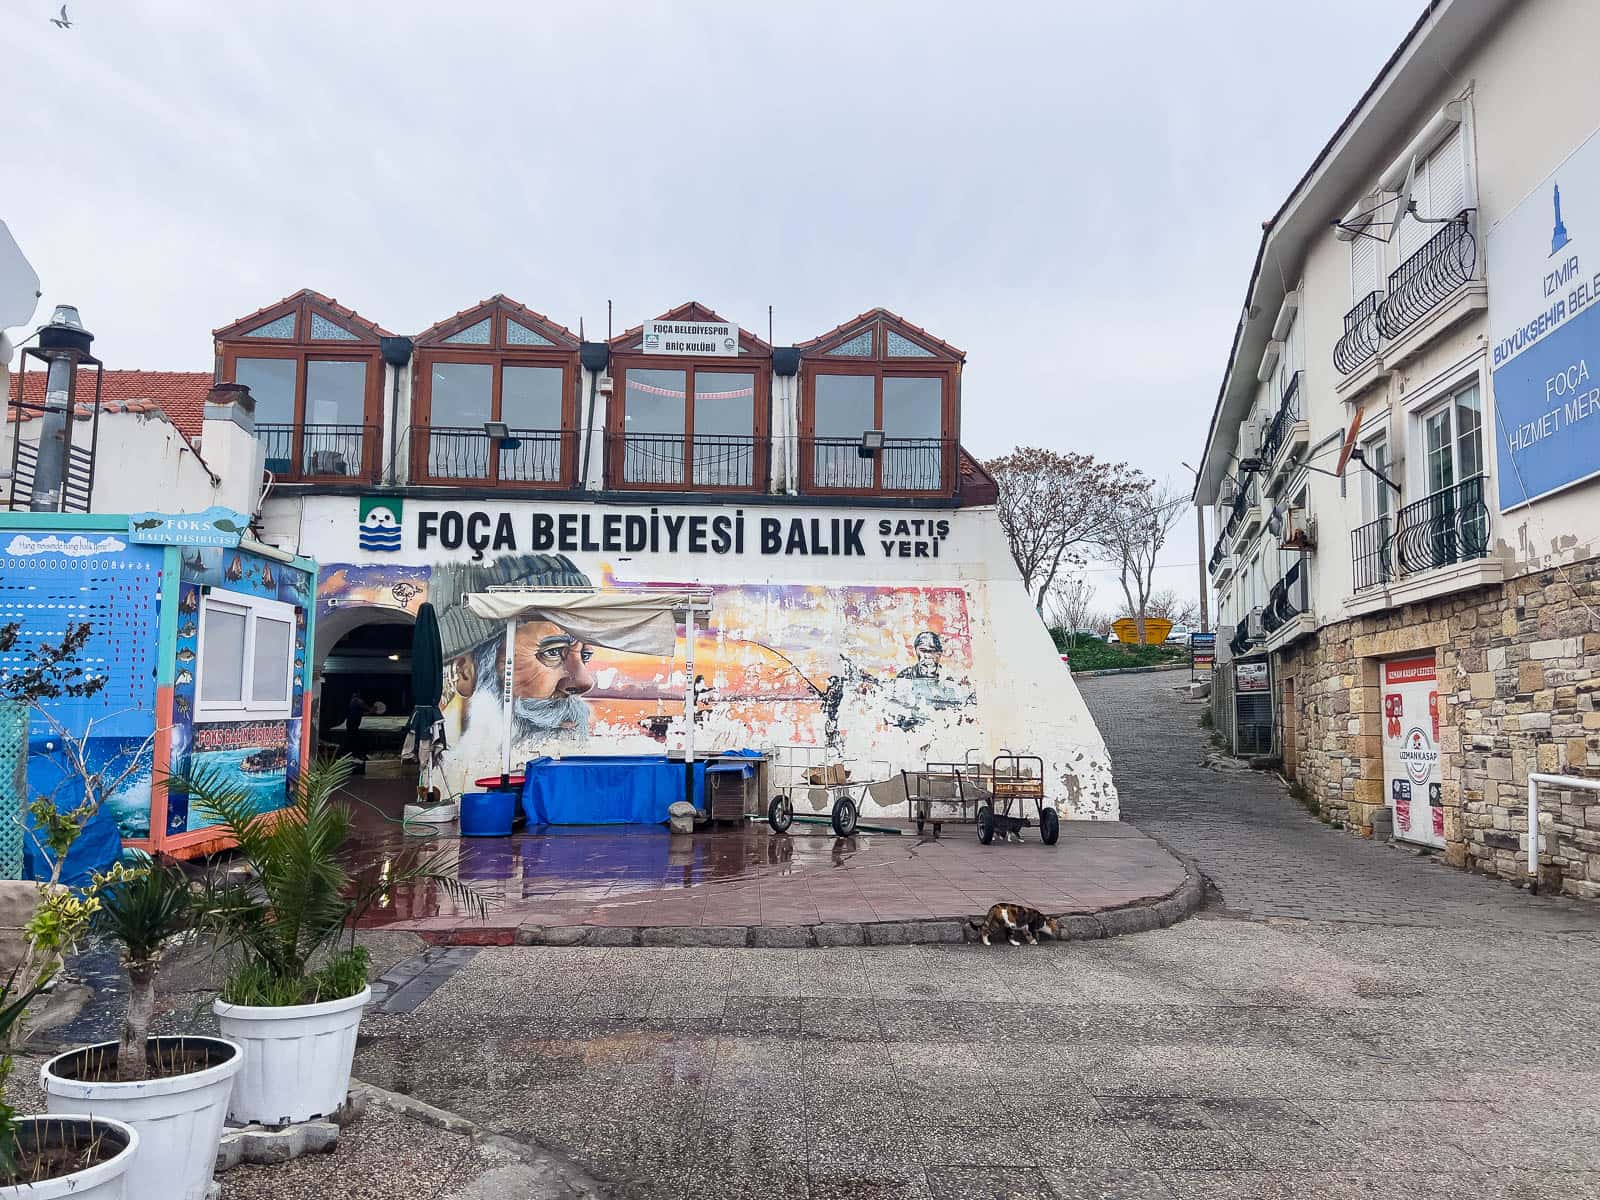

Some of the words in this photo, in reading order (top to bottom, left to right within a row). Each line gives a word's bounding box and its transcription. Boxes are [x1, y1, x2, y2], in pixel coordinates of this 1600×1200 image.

[1543, 255, 1579, 298] İZMİR
[653, 325, 673, 334] FOÇA
[674, 325, 729, 335] BELEDİYESPOR
[1493, 299, 1566, 365] BÜYÜKŞEHİR
[665, 342, 685, 352] BRİÇ
[686, 342, 716, 352] KULÜBÜ
[1545, 359, 1590, 403] FOÇA
[1508, 407, 1562, 456] HİZMET
[1564, 387, 1600, 427] MER
[167, 519, 211, 531] FOKS
[417, 510, 517, 561] FOÇA
[532, 507, 745, 555] BELEDİYESİ
[760, 517, 866, 556] BALIK
[878, 519, 950, 540] SATIŞ
[880, 536, 940, 558] YERİ
[199, 729, 223, 746] FOKS
